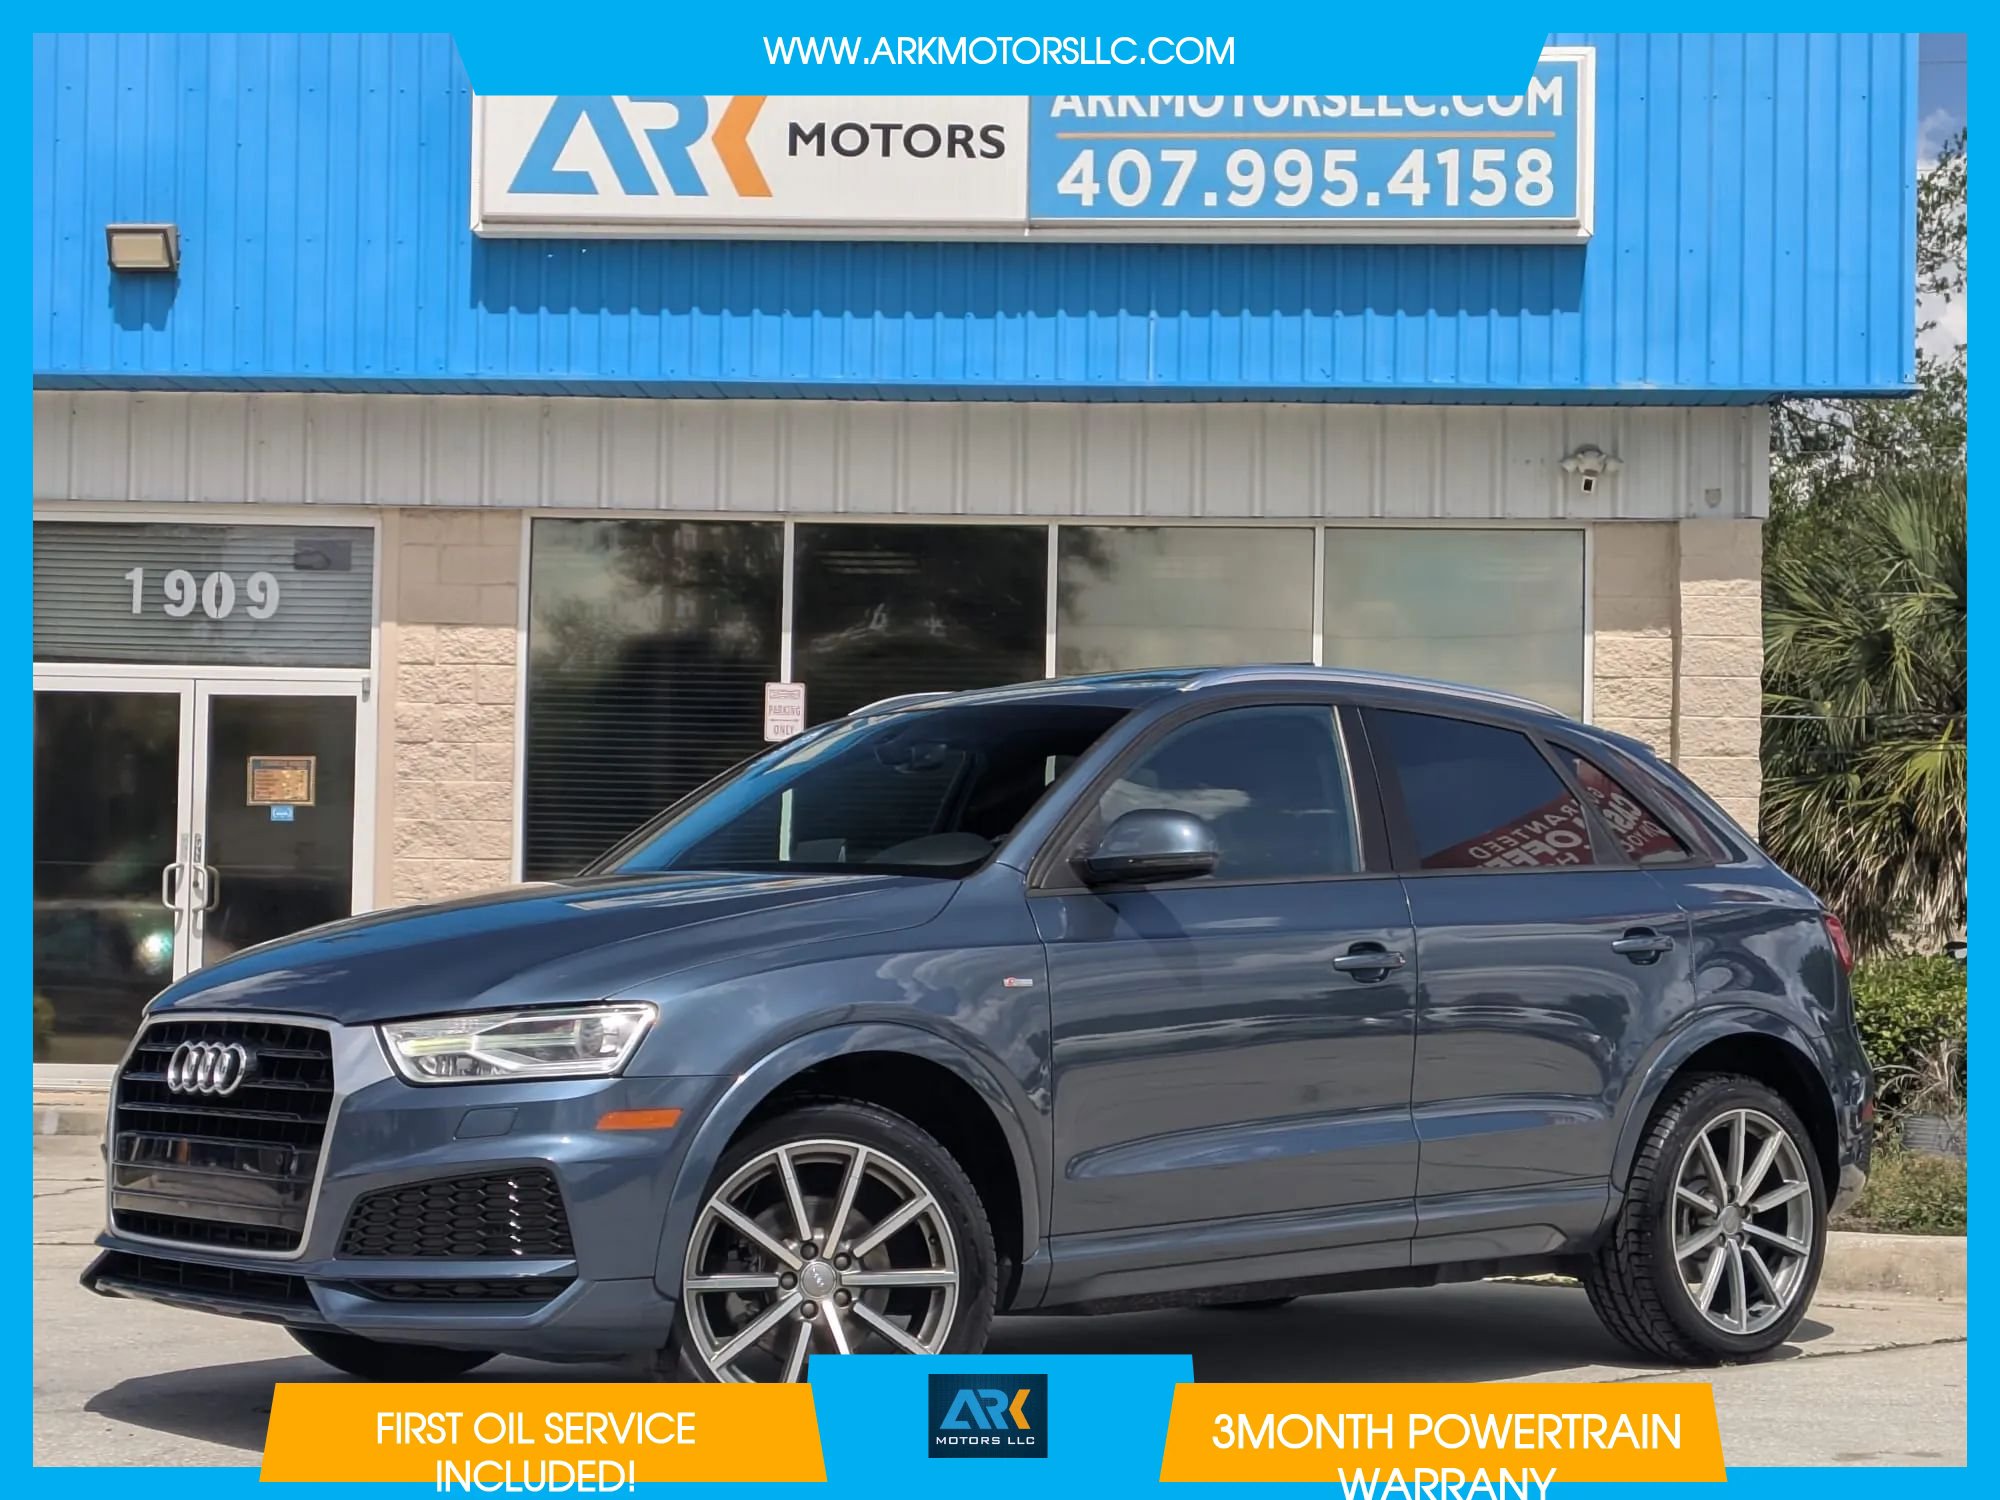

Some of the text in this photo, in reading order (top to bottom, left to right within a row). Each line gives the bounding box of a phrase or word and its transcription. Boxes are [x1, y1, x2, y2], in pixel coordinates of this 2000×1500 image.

[507, 95, 1006, 197] ARK MOTORS
[1056, 148, 1554, 207] 407.995.4158
[124, 567, 280, 619] 1909
[773, 724, 795, 736] ONLY
